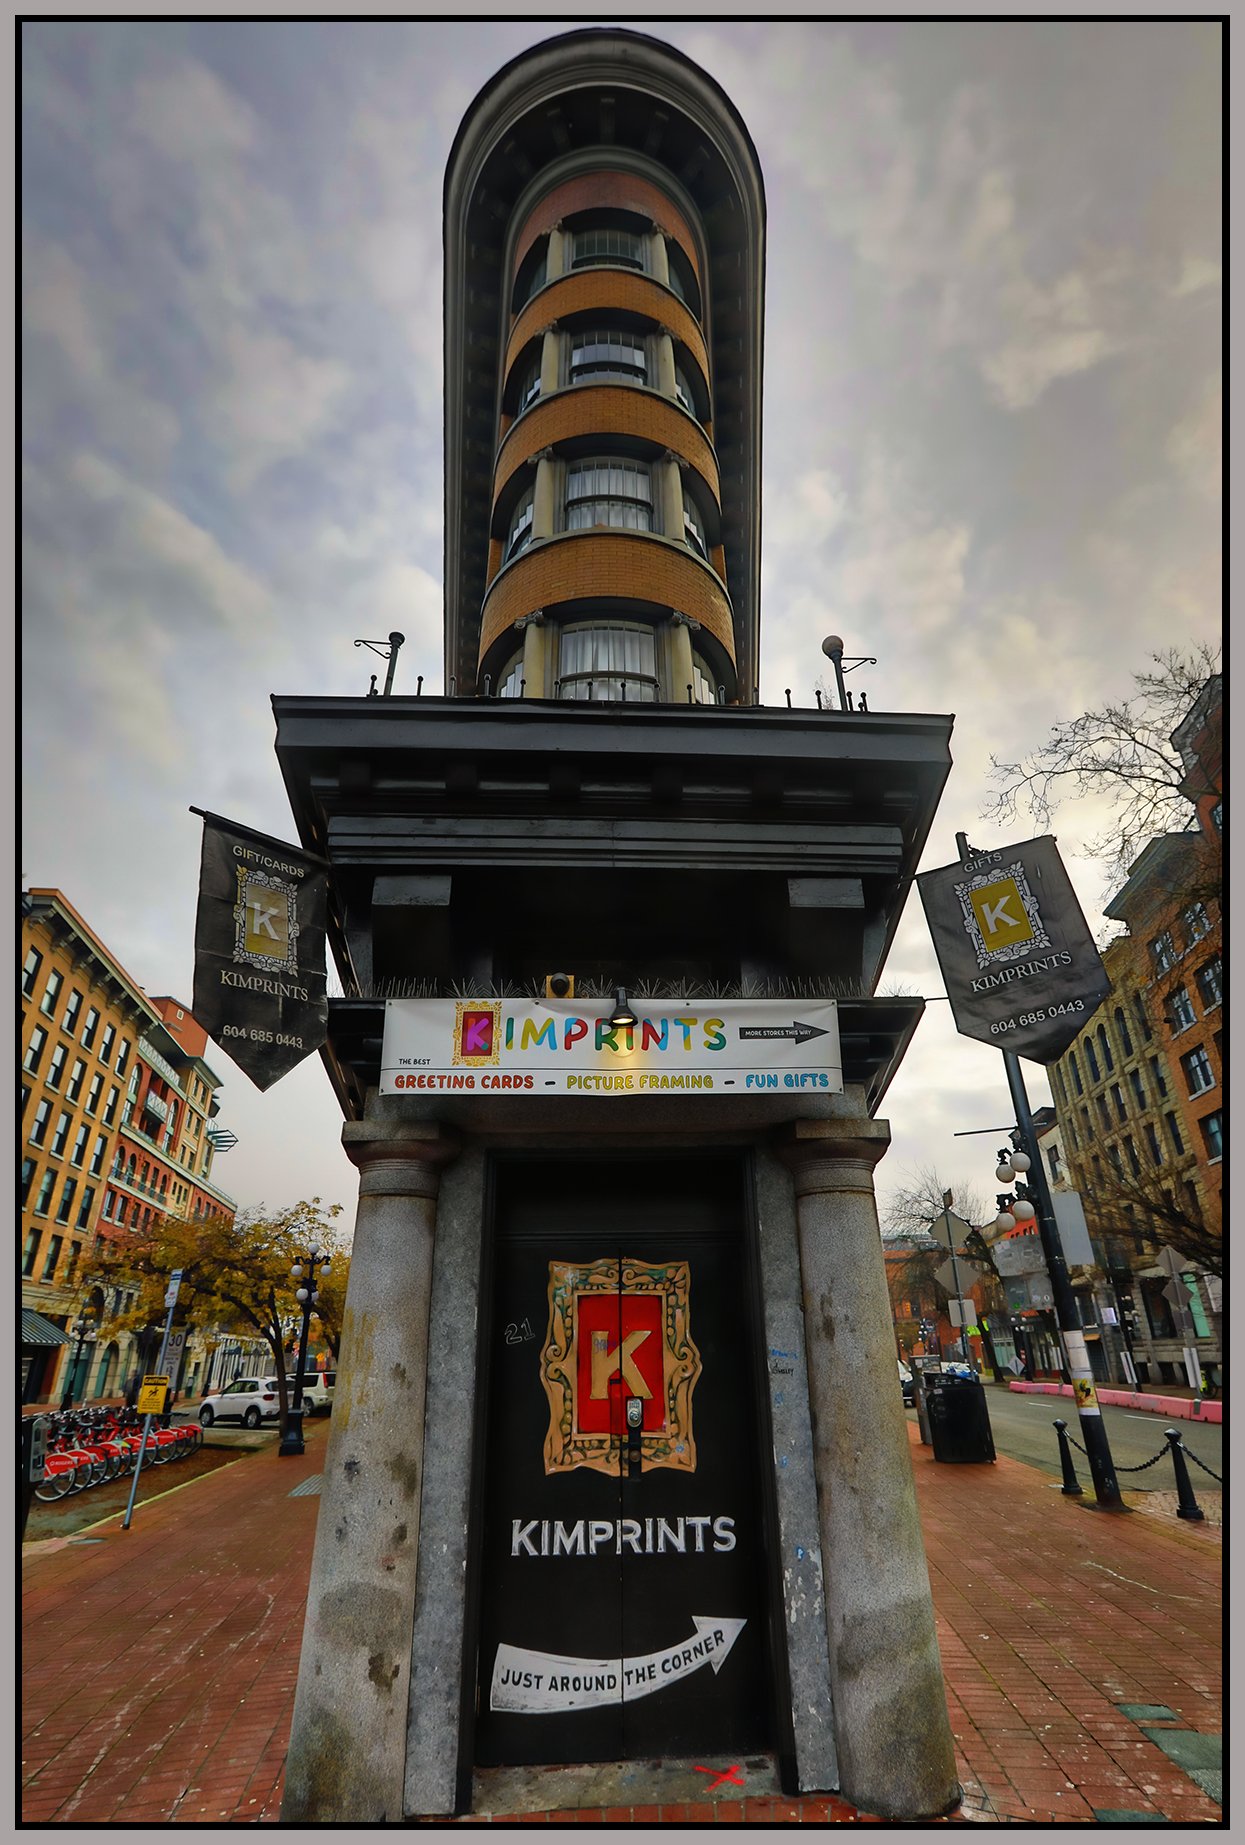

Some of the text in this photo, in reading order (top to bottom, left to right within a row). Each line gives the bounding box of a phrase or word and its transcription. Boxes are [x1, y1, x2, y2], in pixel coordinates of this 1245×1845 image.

[232, 845, 305, 878] GIFT/CARDS
[964, 852, 1002, 873] GIFTS
[252, 902, 281, 941] K
[980, 895, 1021, 934] K
[220, 970, 309, 1002] KIMPRINTS
[970, 951, 1073, 993] KIMPRINTS
[466, 1016, 727, 1051] KIMPRINTS
[990, 999, 1085, 1035] 604 685 0443
[223, 1025, 303, 1048] 604 685 0443
[394, 1074, 476, 1089] GREETING
[480, 1074, 534, 1089] CARDS
[566, 1075, 634, 1090] PICTURE
[639, 1074, 713, 1089] FRAMING
[745, 1073, 778, 1088] FUN
[784, 1073, 829, 1088] GIFTS
[168, 1333, 183, 1348] 30
[504, 1317, 536, 1345] 21
[589, 1330, 653, 1400] K
[510, 1515, 737, 1557] KIMPRINTS
[500, 1628, 725, 1692] JUST AROUND THE CORNER
